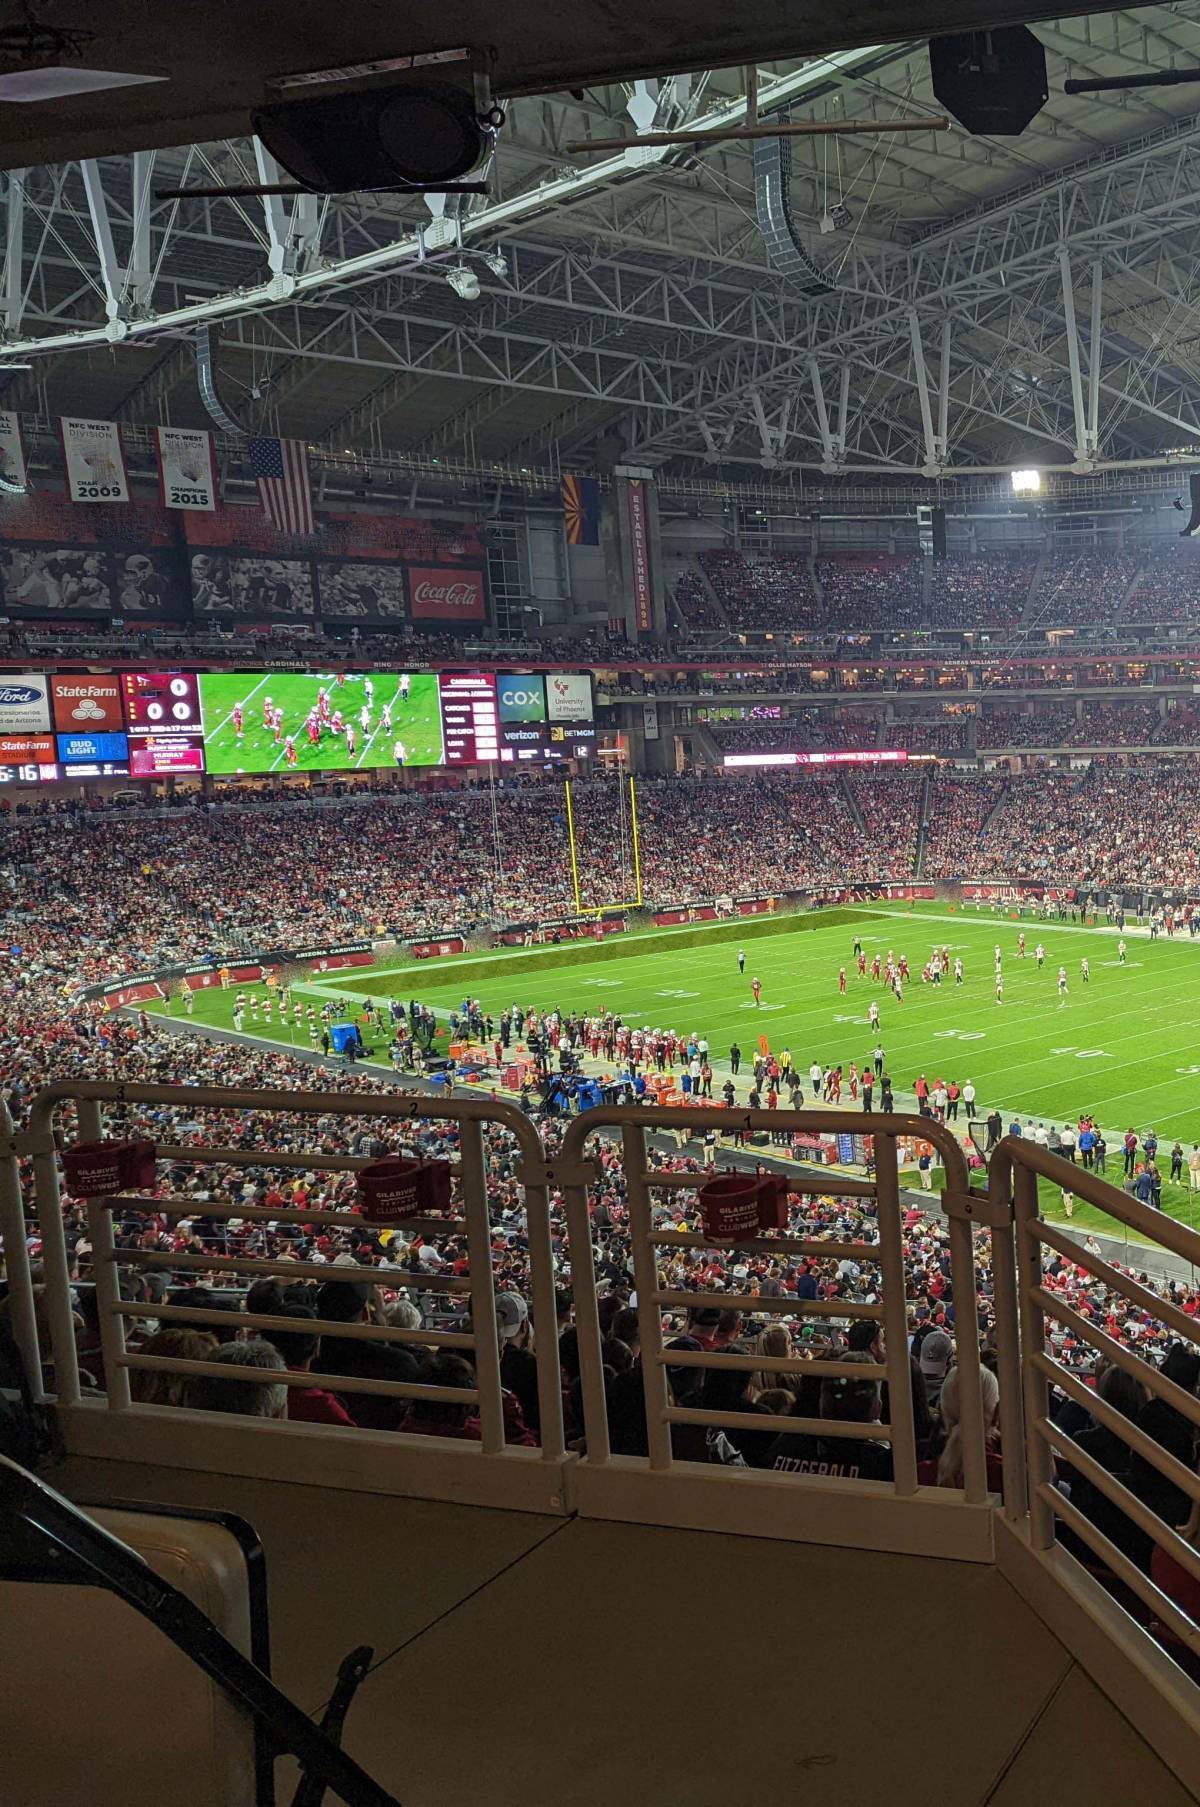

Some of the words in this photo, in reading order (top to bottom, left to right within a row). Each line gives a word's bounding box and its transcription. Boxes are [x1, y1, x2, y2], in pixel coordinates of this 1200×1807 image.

[69, 422, 85, 430] NFC
[87, 423, 111, 432] WEST
[165, 433, 180, 441] NFC
[182, 434, 203, 442] WEST
[78, 486, 121, 498] 2009
[171, 493, 208, 506] 2015
[632, 496, 646, 592] ESTABLISHED
[415, 581, 479, 605] Coca-Cola
[170, 678, 188, 696] 0
[502, 691, 540, 705] COX
[504, 730, 540, 740] verizon
[66, 747, 96, 755] LIGHT
[295, 950, 327, 958] ARIZONA
[330, 945, 368, 954] CARDINALS
[185, 964, 213, 974] ARIZONA
[217, 958, 259, 968] CARDINALS
[933, 1029, 986, 1041] 50
[1050, 1047, 1103, 1058] 40
[117, 1087, 125, 1100] 3
[410, 1102, 419, 1116] 2
[744, 1115, 752, 1129] 1
